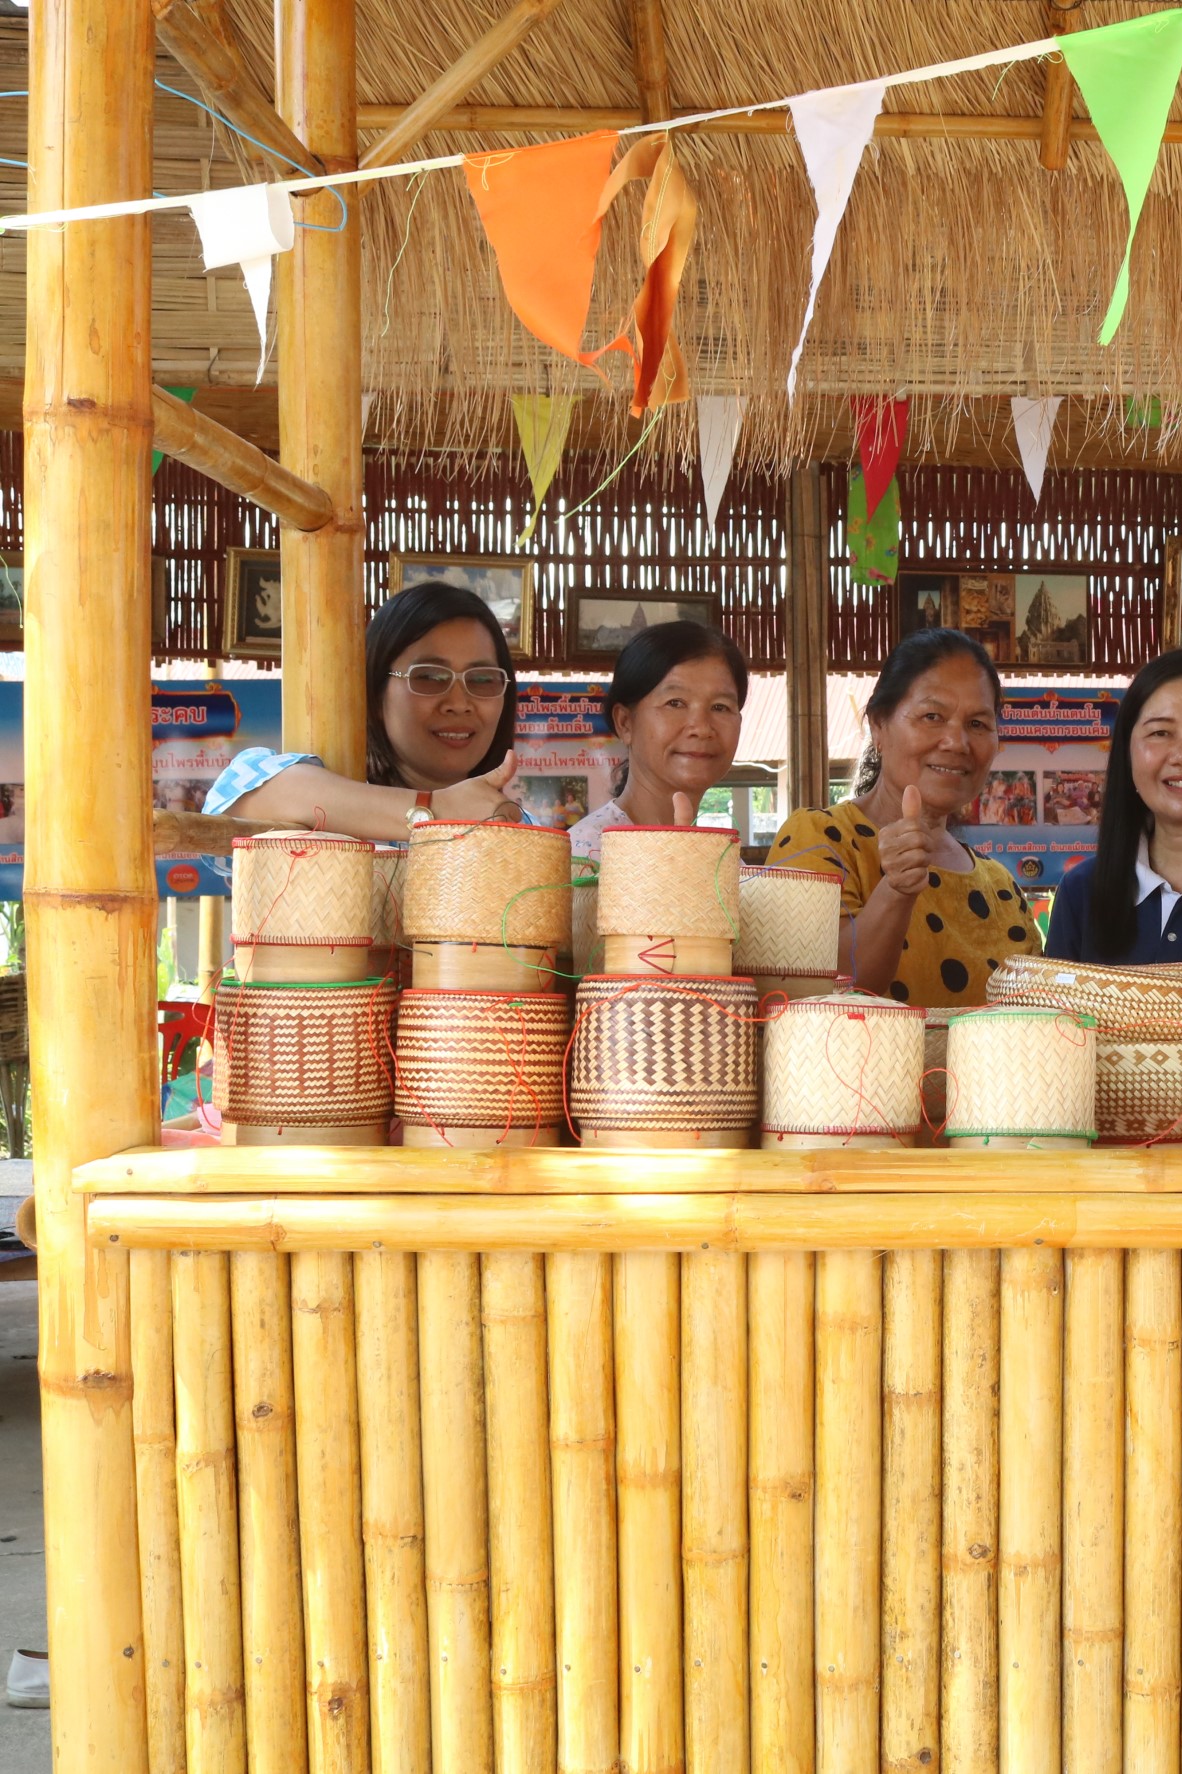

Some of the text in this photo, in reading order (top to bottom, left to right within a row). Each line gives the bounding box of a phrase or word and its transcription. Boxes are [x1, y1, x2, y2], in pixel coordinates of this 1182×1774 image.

[515, 716, 593, 734] หอมดับกลิ่น
